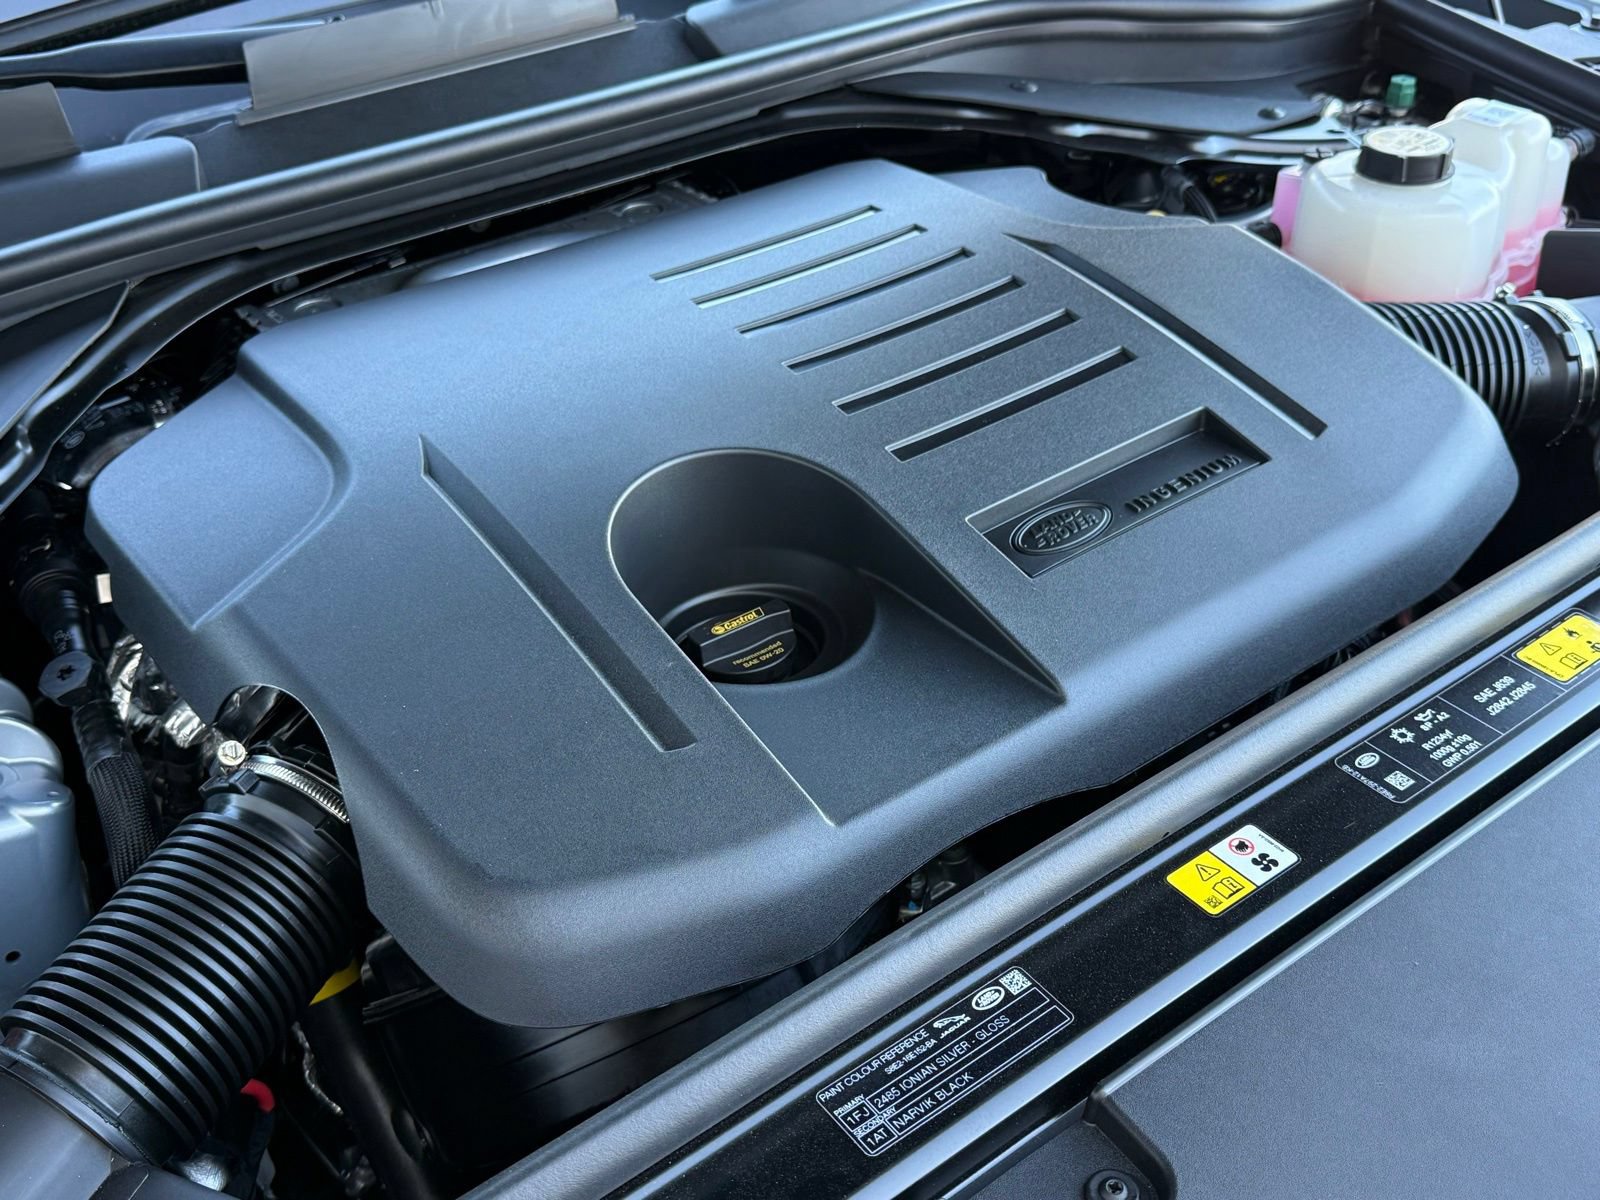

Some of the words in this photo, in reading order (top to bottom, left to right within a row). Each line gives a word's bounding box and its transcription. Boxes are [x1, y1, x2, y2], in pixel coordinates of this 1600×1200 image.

[1125, 454, 1243, 513] INGENIUM
[1030, 511, 1074, 539] LAND
[1047, 513, 1100, 546] ROVER
[723, 611, 758, 630] Castrol
[732, 641, 782, 665] recommended
[742, 658, 760, 668] SAE
[759, 647, 785, 661] 0W-20
[1473, 687, 1497, 703] SAE
[1491, 675, 1515, 692] J639
[1486, 696, 1514, 716] J2842
[1509, 681, 1536, 700] J2845
[1442, 752, 1462, 767] GWP
[1460, 740, 1483, 756] 0.501
[940, 1016, 971, 1039] JAGUAR
[818, 1081, 845, 1102] PAINT
[844, 1059, 883, 1086] COLOUR
[879, 1029, 930, 1064] REFERENCE
[873, 1086, 901, 1108] 2485
[898, 1062, 937, 1091] IONIAN
[935, 1040, 971, 1067] SILVER
[975, 1015, 1010, 1040] GLOSS
[833, 1094, 865, 1117] PRIMARY
[892, 1097, 937, 1129] NARVIK
[934, 1072, 974, 1101] BLACK
[846, 1106, 870, 1124] 1FJ
[853, 1105, 898, 1138] SECONDARY
[866, 1127, 888, 1146] 1AT
